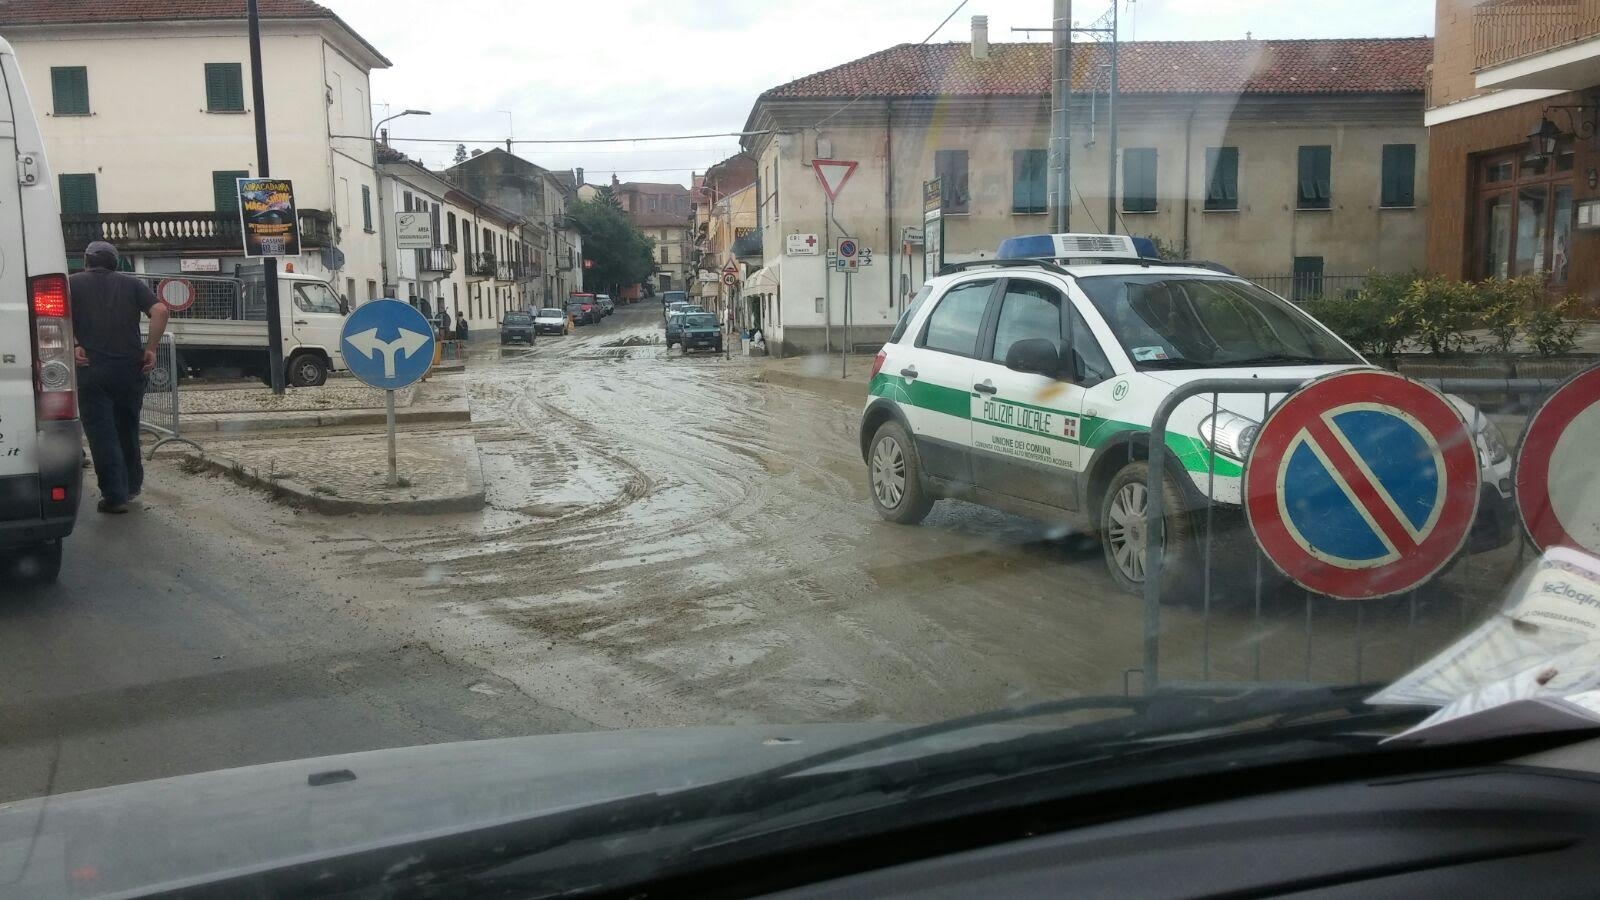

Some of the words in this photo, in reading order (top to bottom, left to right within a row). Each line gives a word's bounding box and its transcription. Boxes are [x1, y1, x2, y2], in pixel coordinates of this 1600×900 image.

[1115, 385, 1126, 396] 01
[983, 401, 1014, 424] POLIZIA
[1017, 408, 1052, 433] LOCALE
[992, 436, 1014, 447] UNIONE
[1015, 440, 1025, 450] DEI
[1025, 442, 1051, 455] COMUNI
